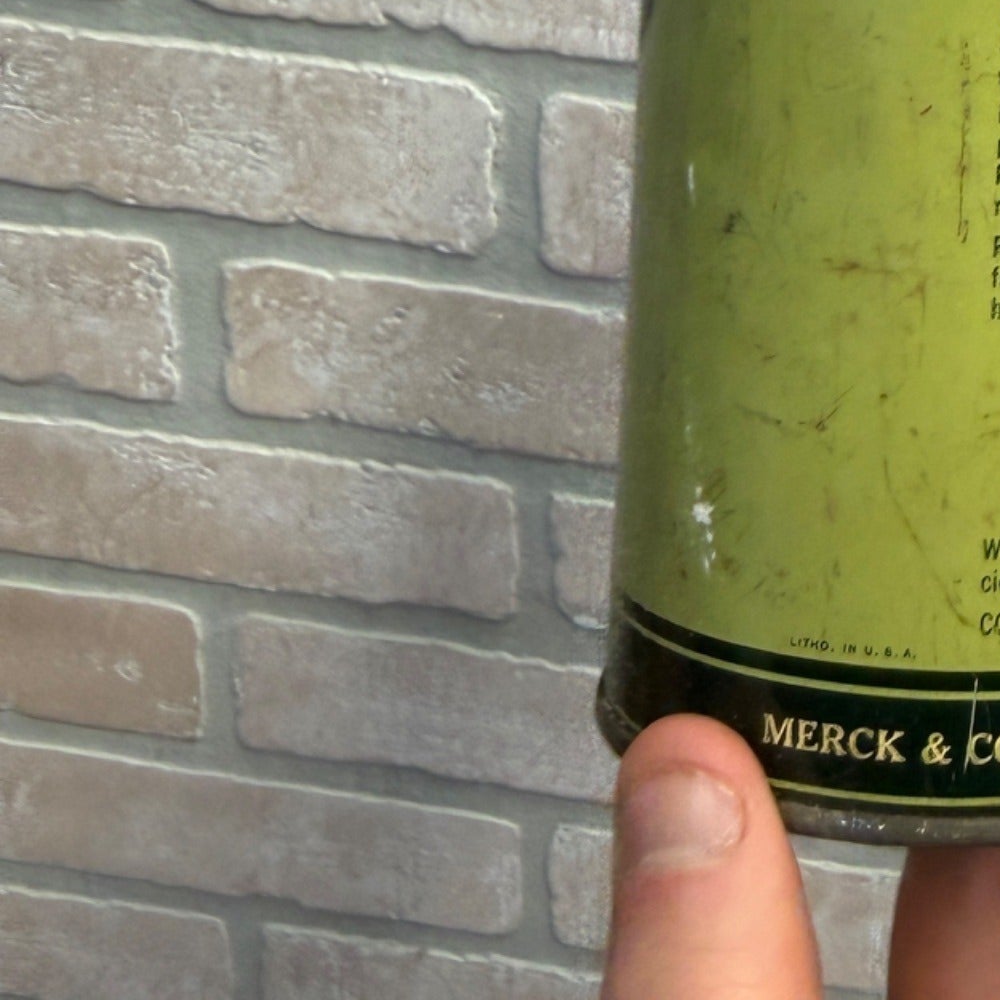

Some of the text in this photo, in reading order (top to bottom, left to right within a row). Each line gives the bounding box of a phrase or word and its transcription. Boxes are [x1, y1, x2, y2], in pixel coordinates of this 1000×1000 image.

[842, 643, 857, 654] IN
[761, 712, 907, 764] MERCK
[920, 731, 953, 766] &
